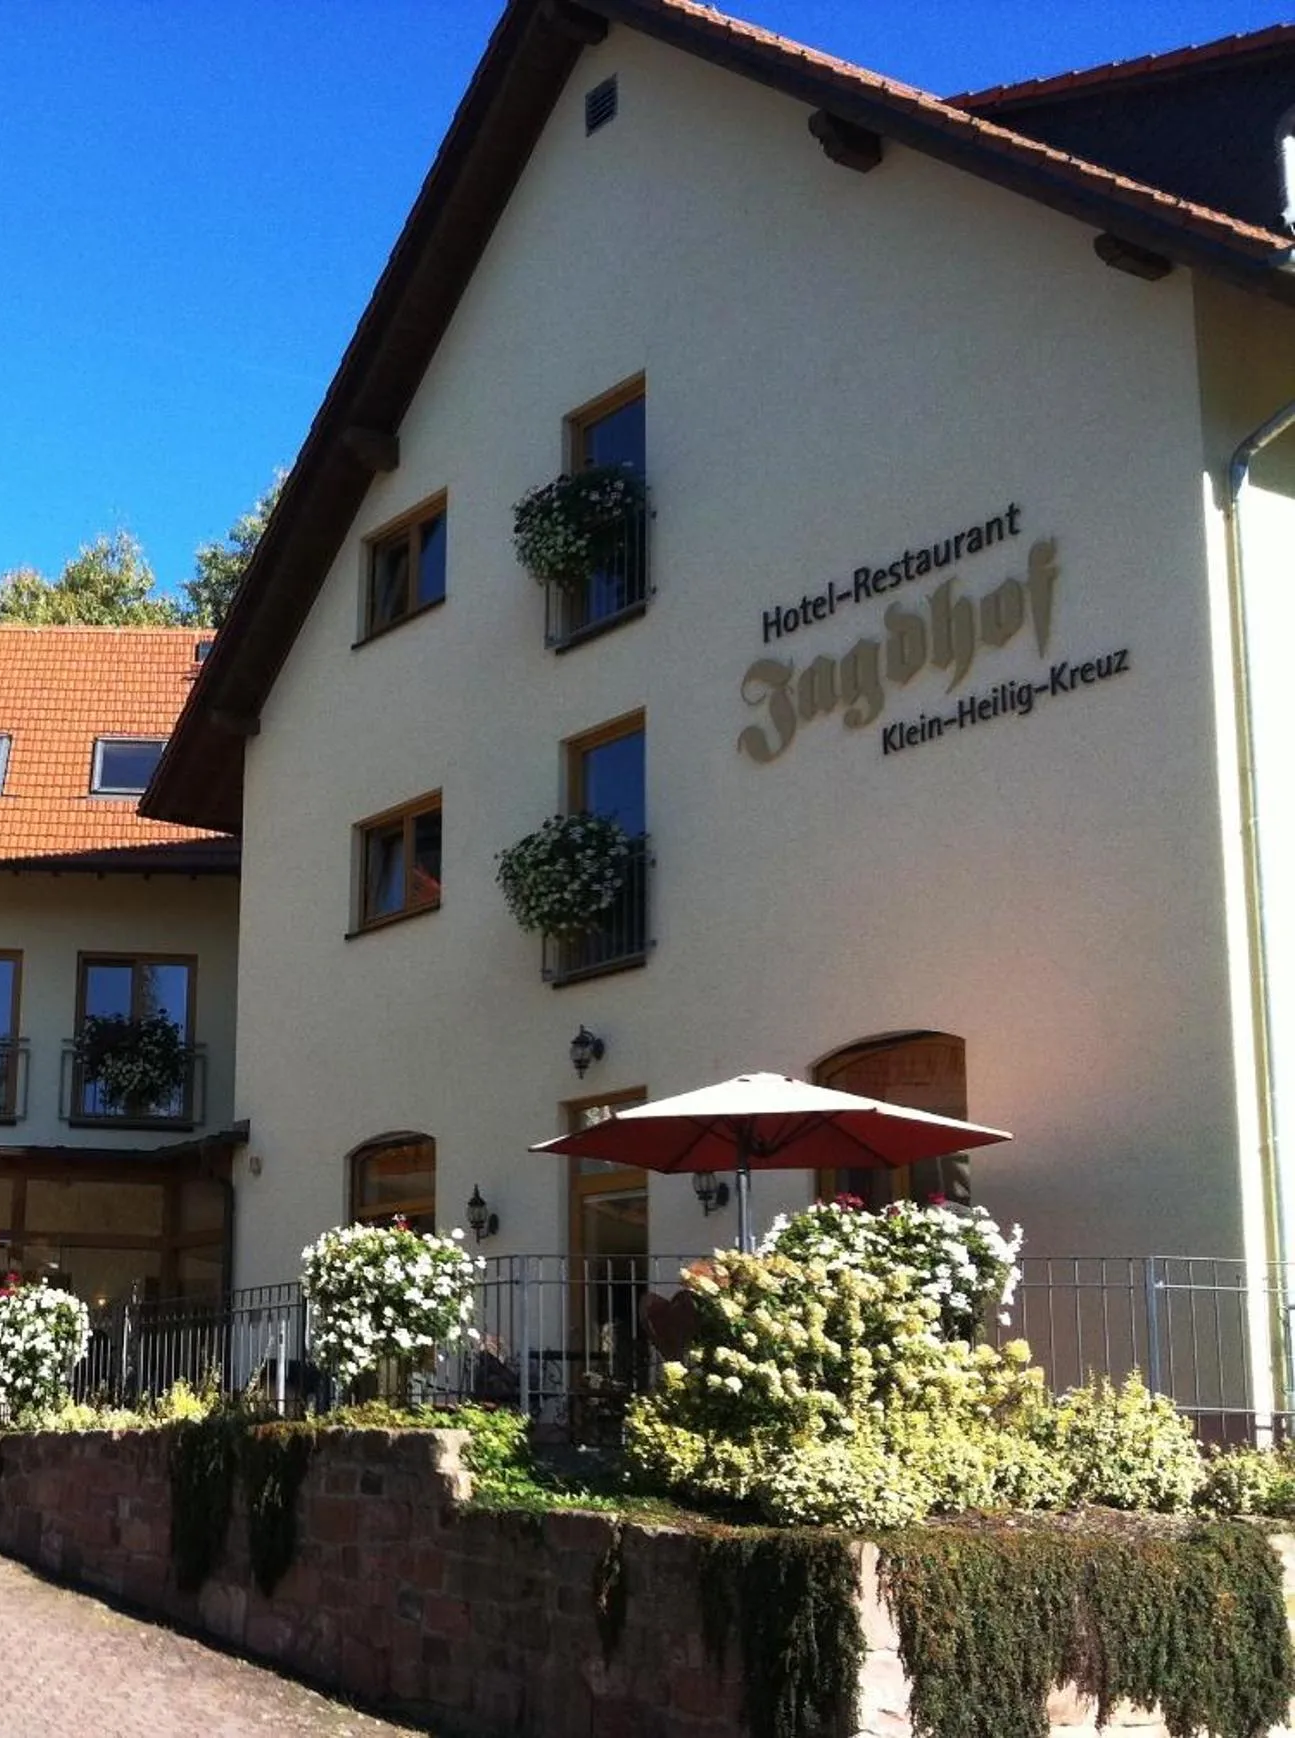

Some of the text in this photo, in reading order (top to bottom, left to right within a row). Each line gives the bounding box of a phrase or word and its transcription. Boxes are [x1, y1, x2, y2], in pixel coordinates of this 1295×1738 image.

[762, 502, 1022, 643] Hotel-Restaurant
[737, 536, 1060, 764] Jagdhof
[882, 648, 1130, 755] Klein-Heilig-Kreuz
